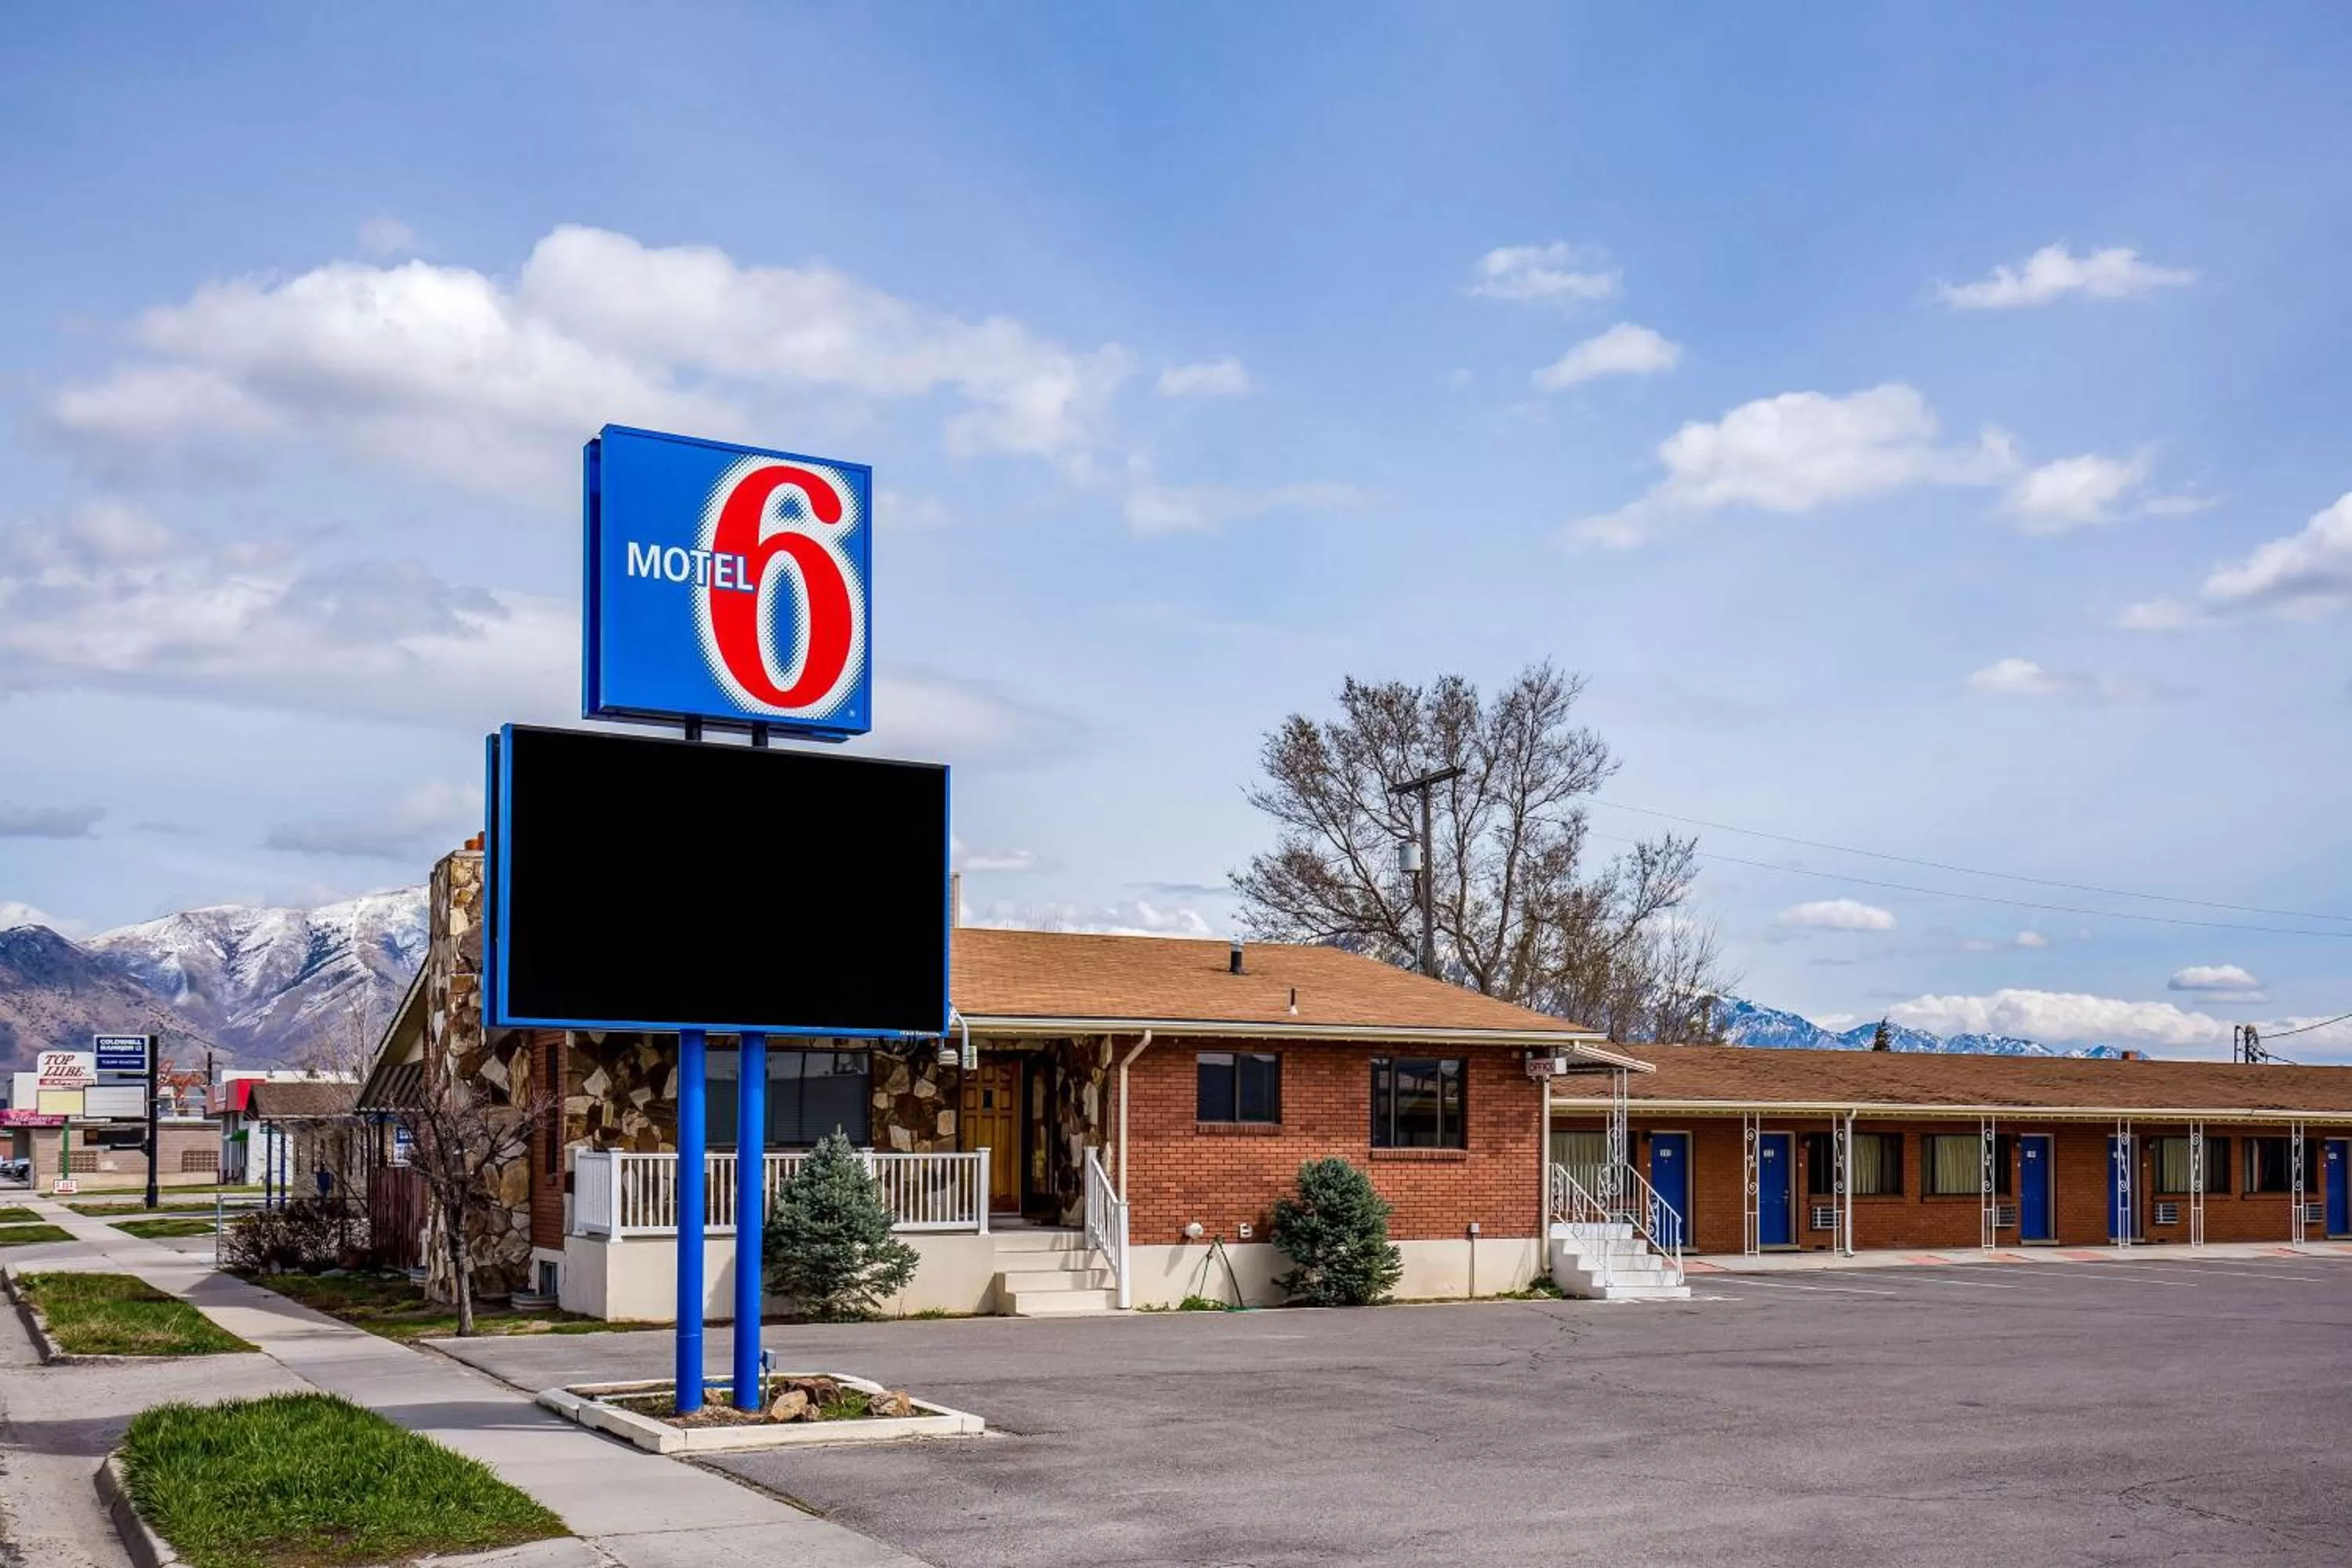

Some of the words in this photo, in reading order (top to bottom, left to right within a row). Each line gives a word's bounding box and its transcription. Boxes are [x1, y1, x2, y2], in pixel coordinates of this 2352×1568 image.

[628, 541, 754, 591] MOTEL
[710, 464, 853, 709] 6
[44, 1054, 75, 1065] TOP
[44, 1066, 85, 1076] LUBE
